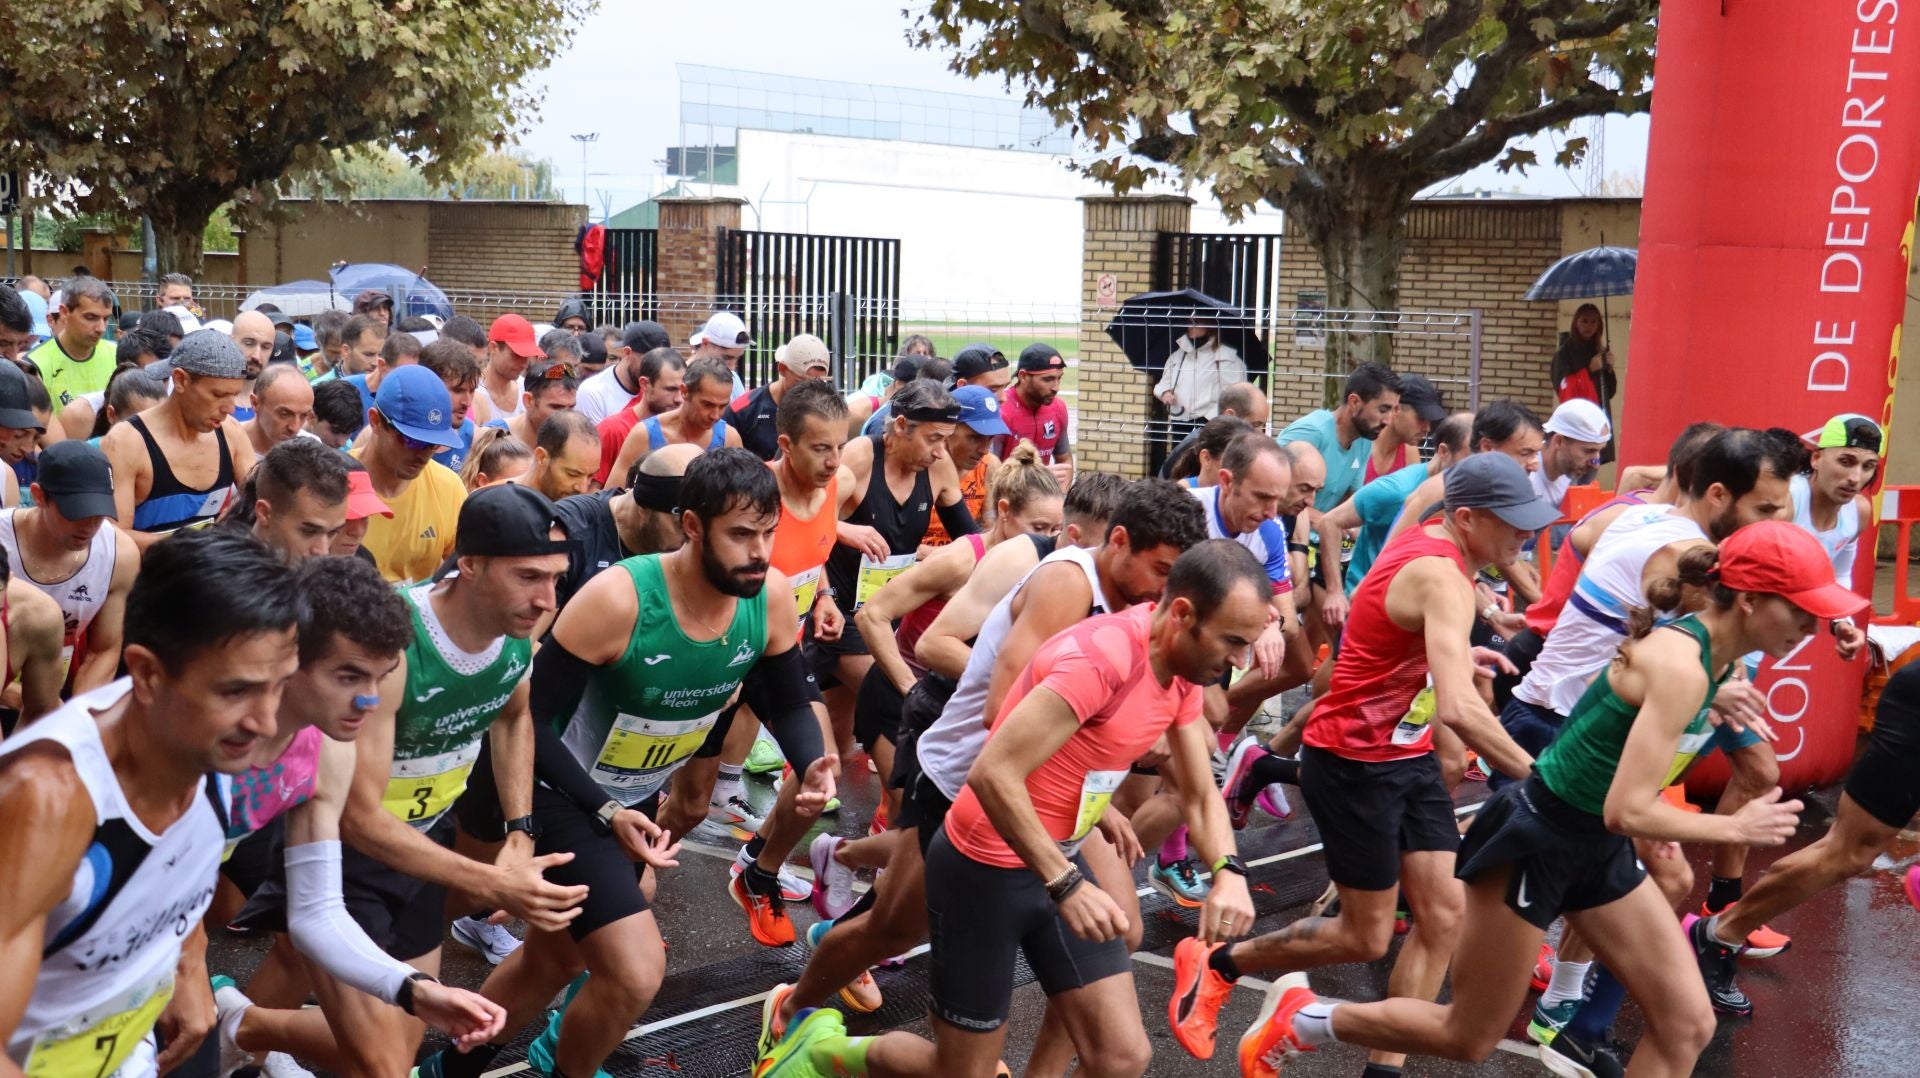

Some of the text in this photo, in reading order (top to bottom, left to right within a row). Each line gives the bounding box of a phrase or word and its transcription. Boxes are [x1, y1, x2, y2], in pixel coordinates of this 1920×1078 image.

[1820, 0, 1899, 292] DEPORTES
[1807, 320, 1857, 391] DE
[663, 677, 741, 700] universidad
[670, 697, 699, 708] león
[641, 743, 676, 769] 111
[408, 787, 433, 819] 3
[96, 1033, 118, 1078] 7
